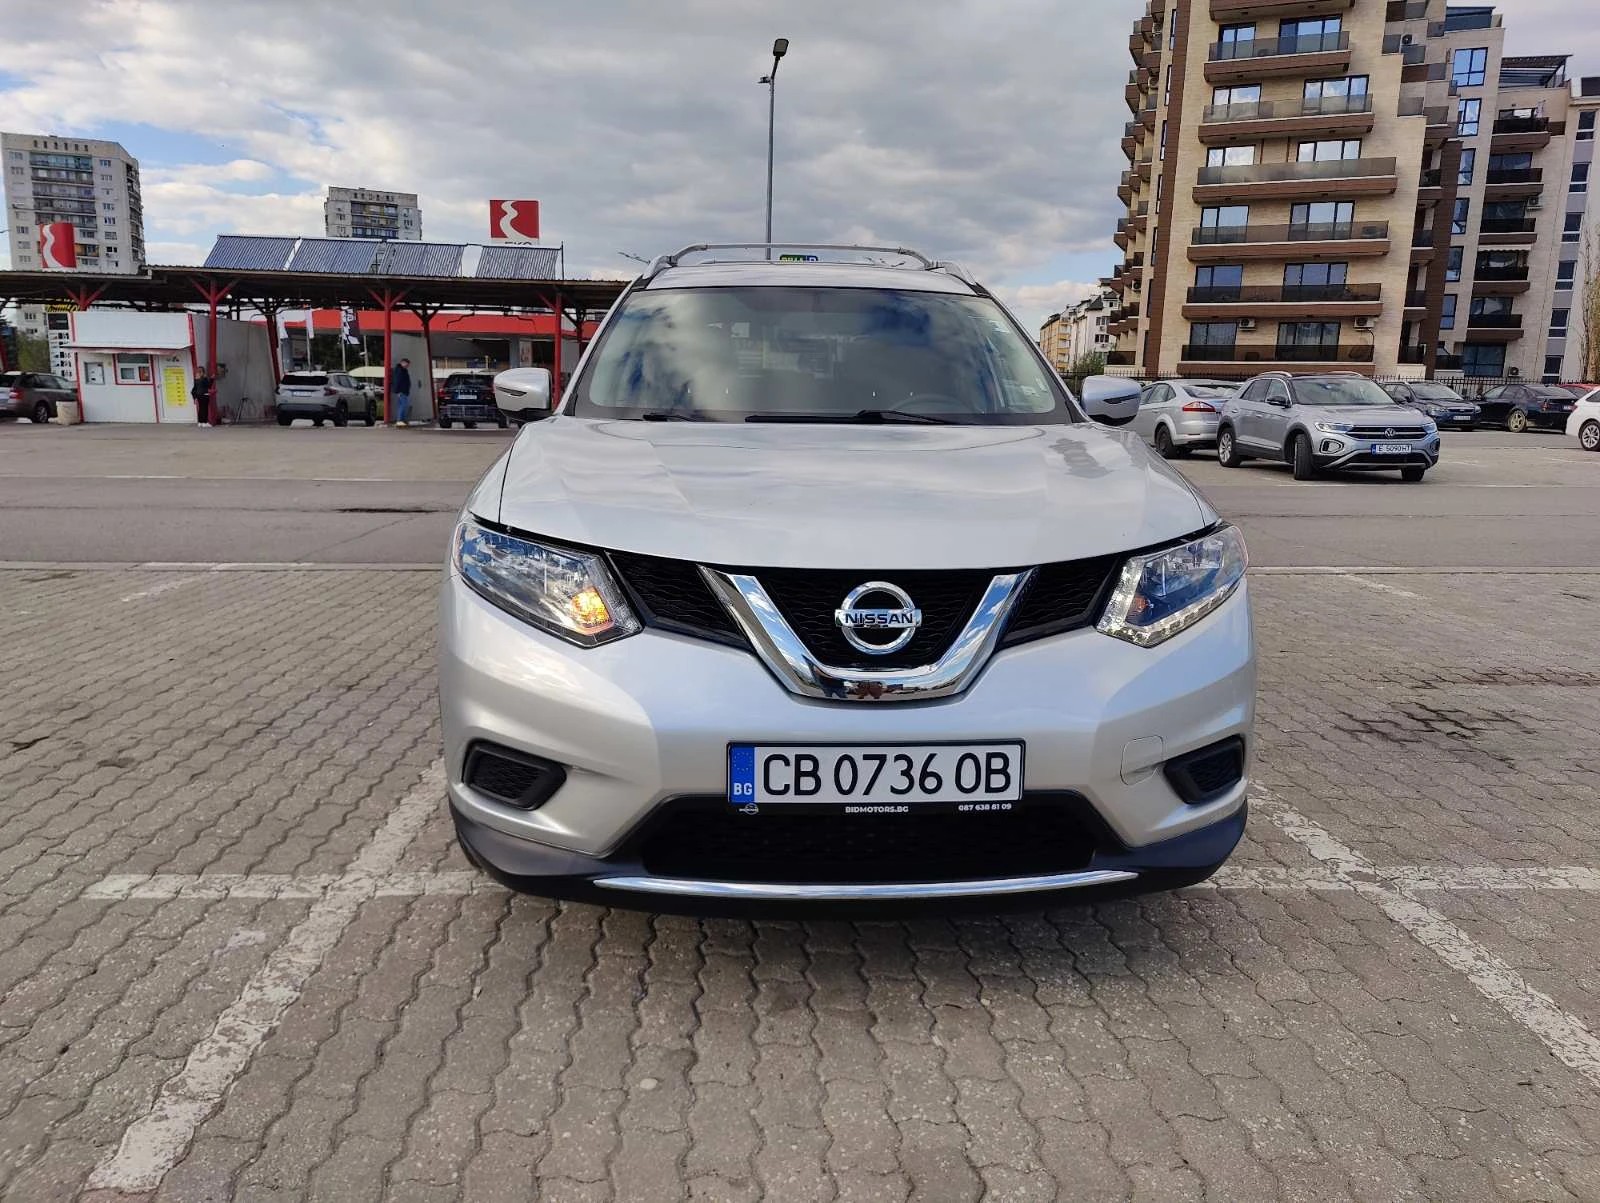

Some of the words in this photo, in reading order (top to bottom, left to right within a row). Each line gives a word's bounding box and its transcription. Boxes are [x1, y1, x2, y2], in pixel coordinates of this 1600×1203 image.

[845, 613, 914, 624] NISSAN
[763, 753, 822, 796] CB
[833, 753, 943, 796] 0736
[955, 752, 1011, 794] OB
[733, 782, 753, 795] BG
